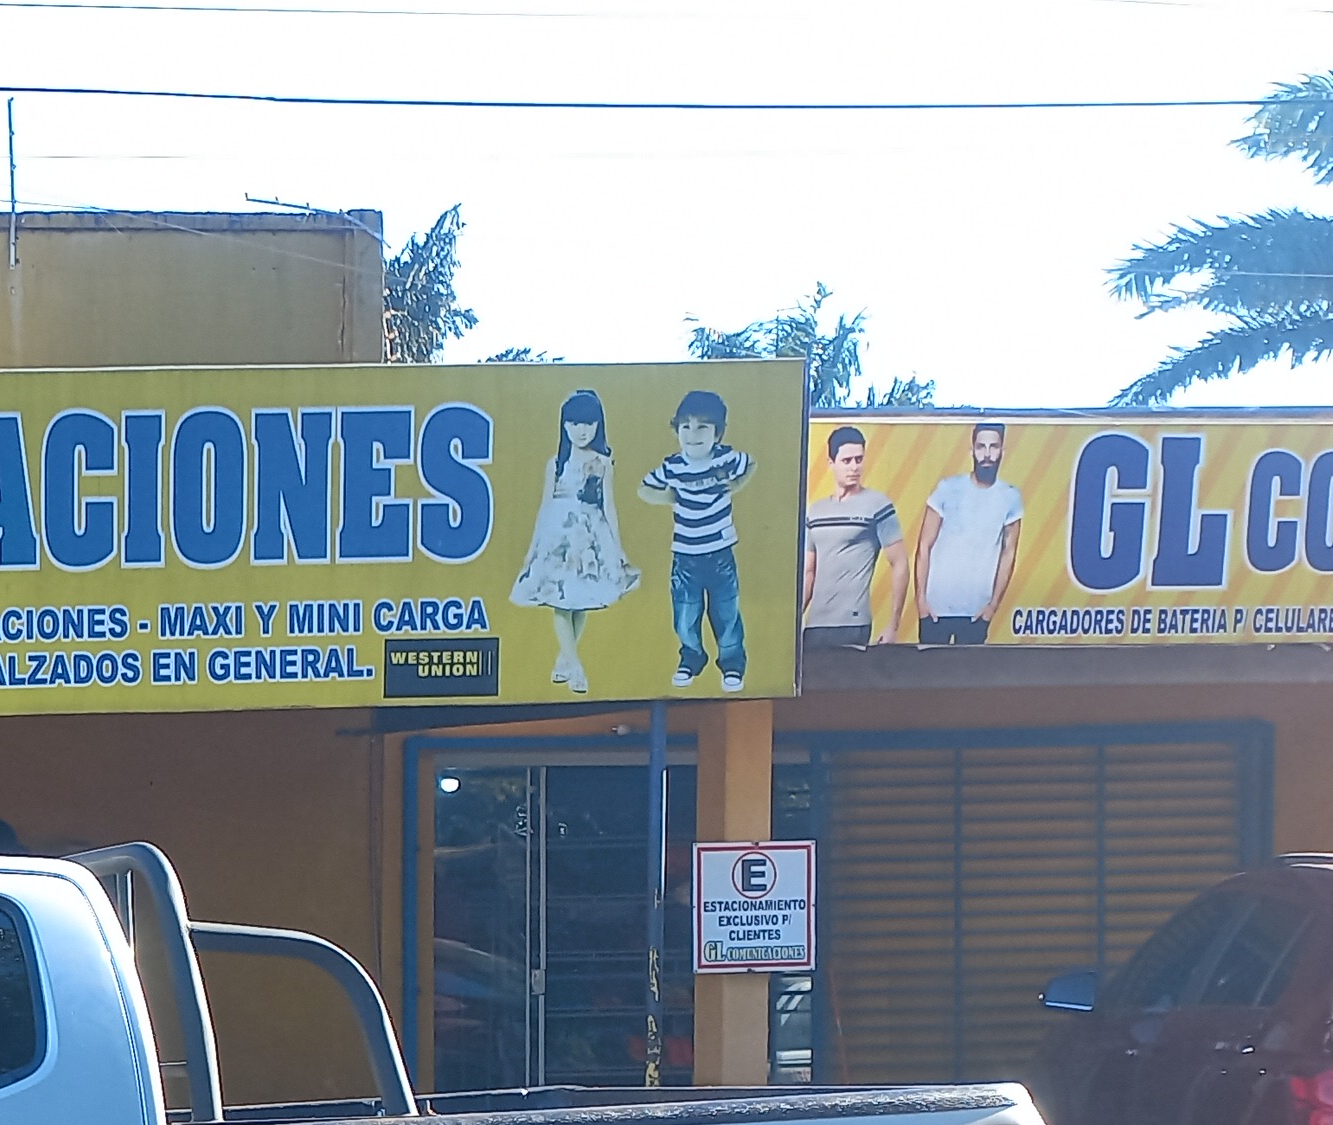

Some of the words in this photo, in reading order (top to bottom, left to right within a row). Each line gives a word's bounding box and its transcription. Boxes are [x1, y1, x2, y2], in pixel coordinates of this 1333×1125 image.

[1070, 433, 1230, 591] GL
[158, 605, 245, 637] MAXI
[254, 605, 277, 635] Y
[288, 602, 362, 634] MINI
[373, 599, 489, 632] CARGA
[1012, 609, 1125, 635] CARGADORES
[1130, 609, 1153, 635] DE
[1157, 609, 1227, 635] BATERIA
[151, 651, 196, 683] EN
[208, 647, 374, 682] GENERAL.
[390, 651, 478, 665] WESTERN
[418, 664, 478, 677] UNION
[741, 858, 768, 892] E
[703, 899, 806, 912] ESTACIONAMIENTO
[718, 914, 779, 927] EXCLUSIVO
[728, 929, 781, 941] CLIENTES
[704, 940, 727, 962] GL
